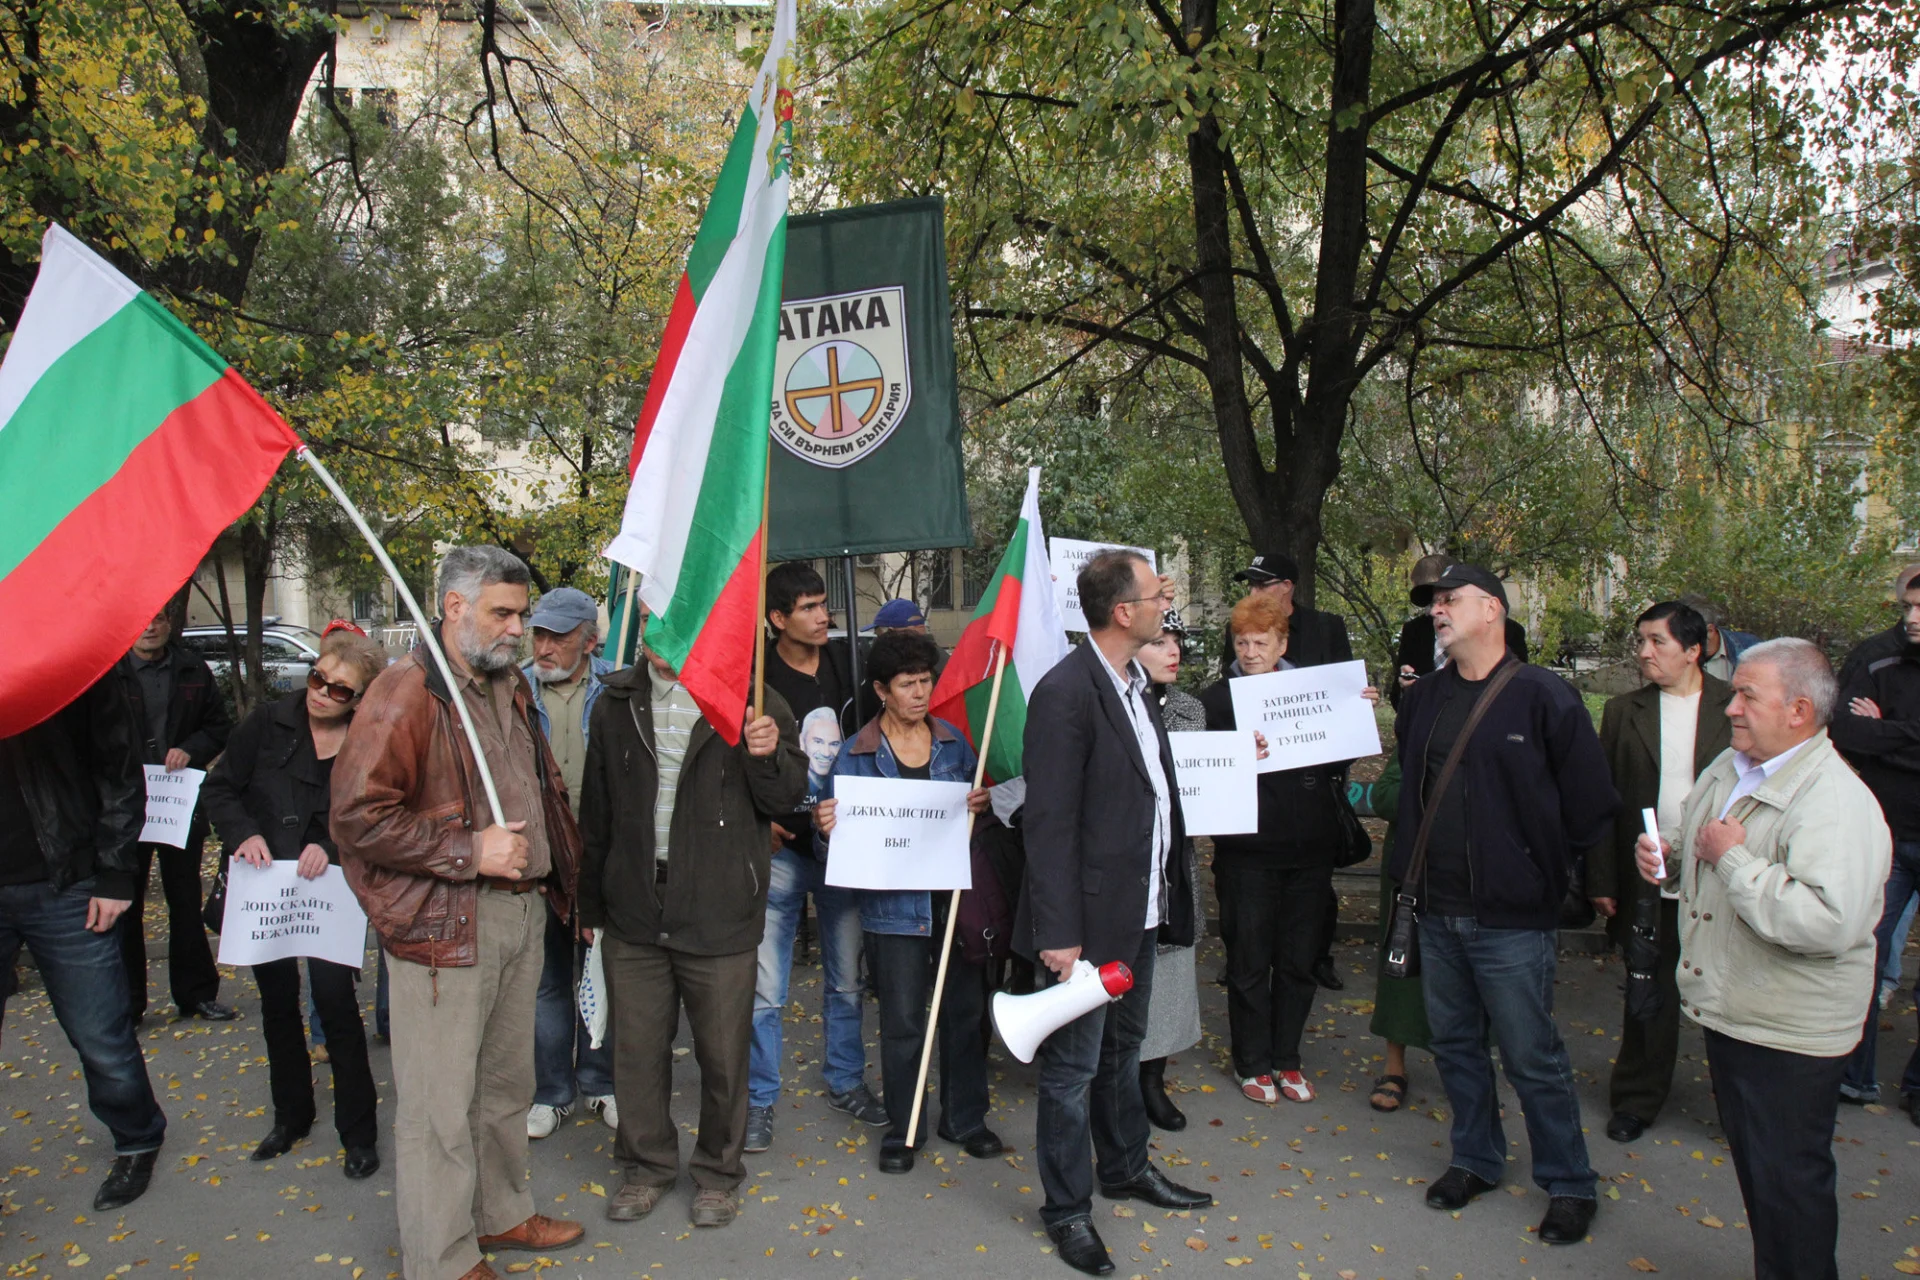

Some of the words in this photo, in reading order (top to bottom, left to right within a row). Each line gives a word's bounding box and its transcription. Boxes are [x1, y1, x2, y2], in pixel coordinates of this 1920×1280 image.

[777, 296, 890, 341] АТАКА
[778, 420, 796, 440] СИ
[795, 436, 854, 456] ВЪРНЕМ
[855, 382, 901, 449] БЪЛГАРИЯ
[1262, 690, 1329, 708] ЗАТВОРЕТЕ
[1263, 704, 1332, 722] ГРАНИЦАТА
[1295, 721, 1304, 730] С
[1276, 731, 1327, 746] ТУРЦИЯ
[847, 805, 948, 820] ДЖИХАДИСТИТЕ
[884, 837, 911, 848] ВЪН!
[281, 887, 298, 897] НЕ
[241, 897, 334, 912] ДОПУСКАЙТЕ
[260, 912, 314, 926] ПОВЕЧЕ
[251, 925, 320, 940] БЕЖАНЦИ
